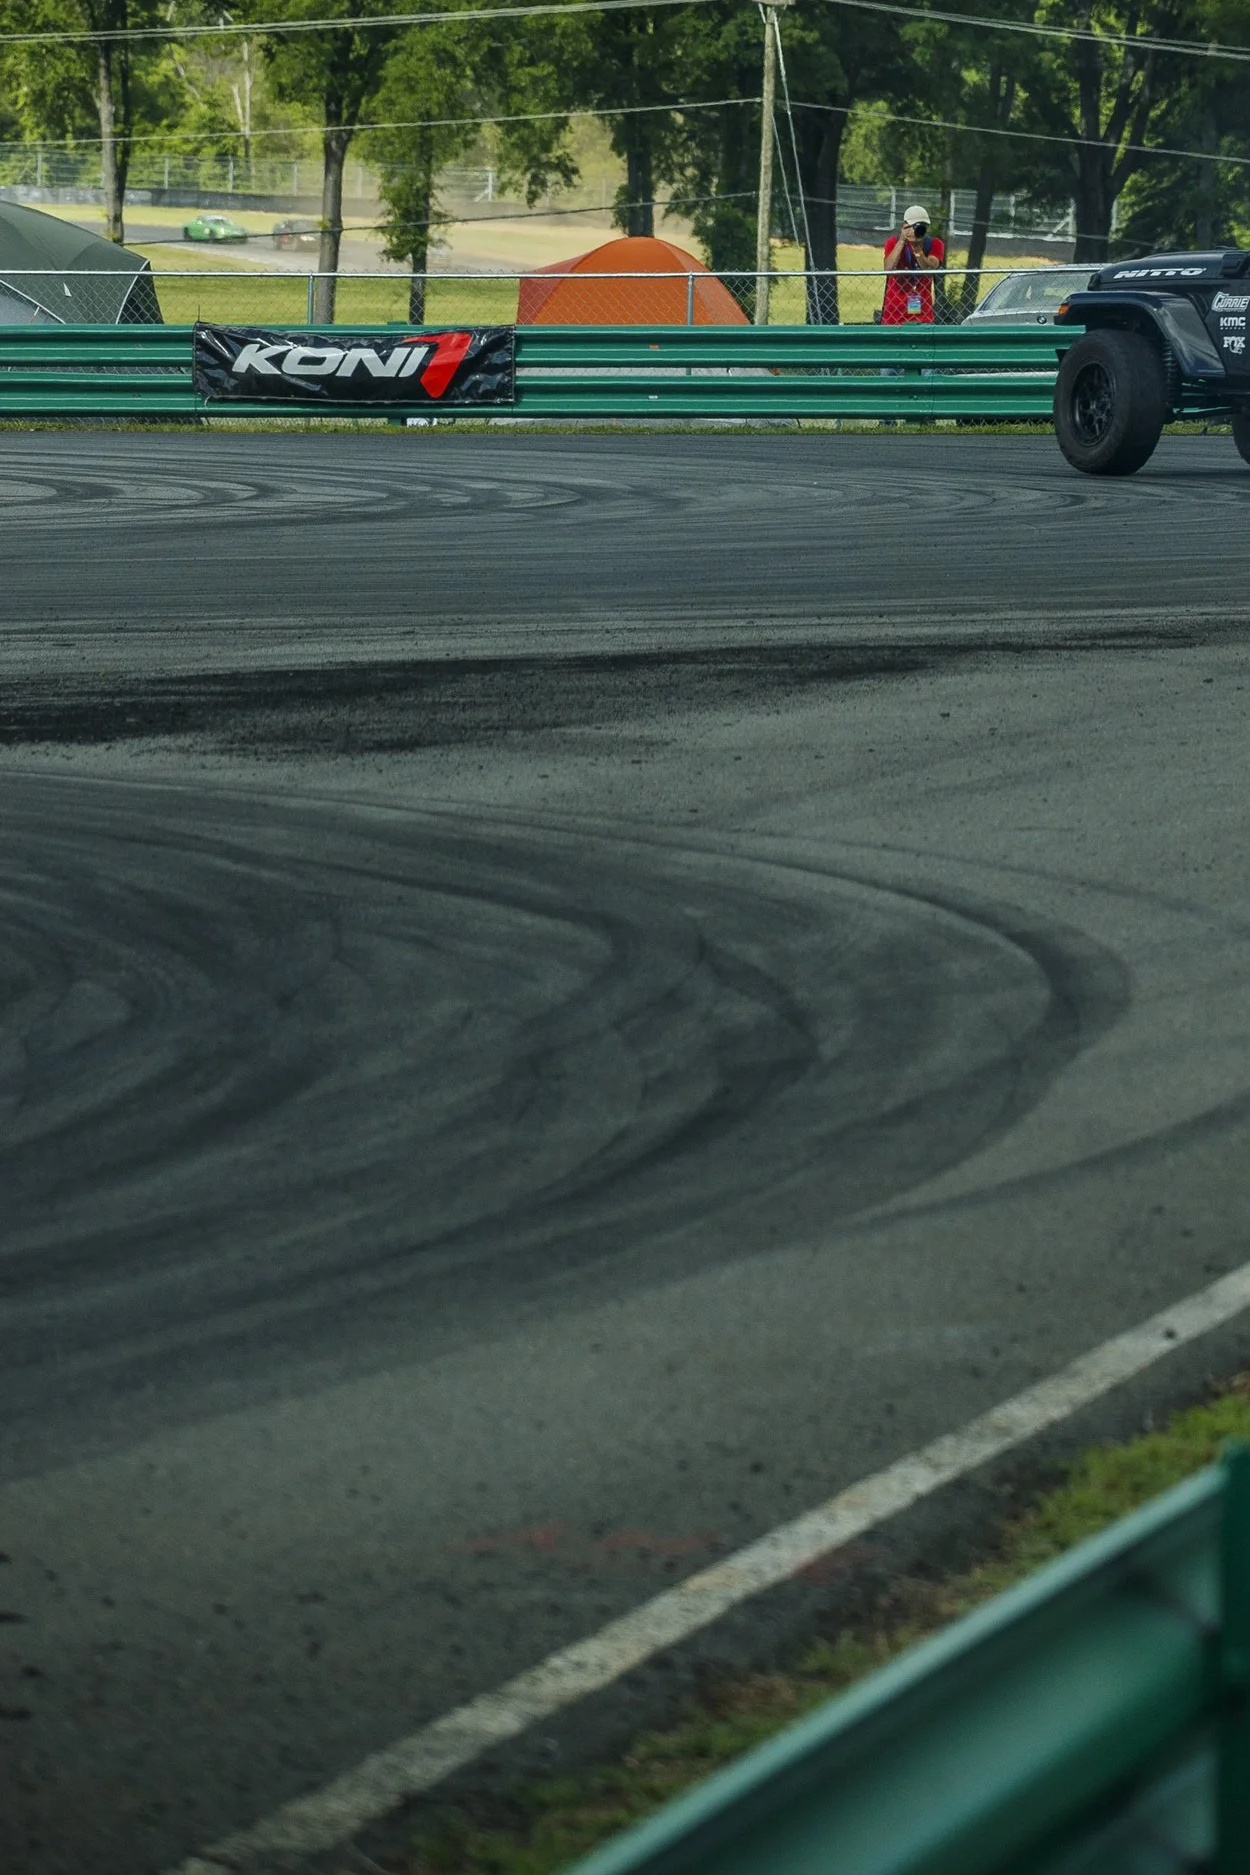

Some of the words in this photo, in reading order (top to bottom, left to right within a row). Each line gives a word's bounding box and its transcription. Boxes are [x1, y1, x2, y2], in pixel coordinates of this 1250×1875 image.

[1113, 267, 1206, 279] NITTO
[1220, 317, 1246, 326] KMC
[1223, 336, 1246, 354] FOX
[232, 344, 429, 378] KONI
